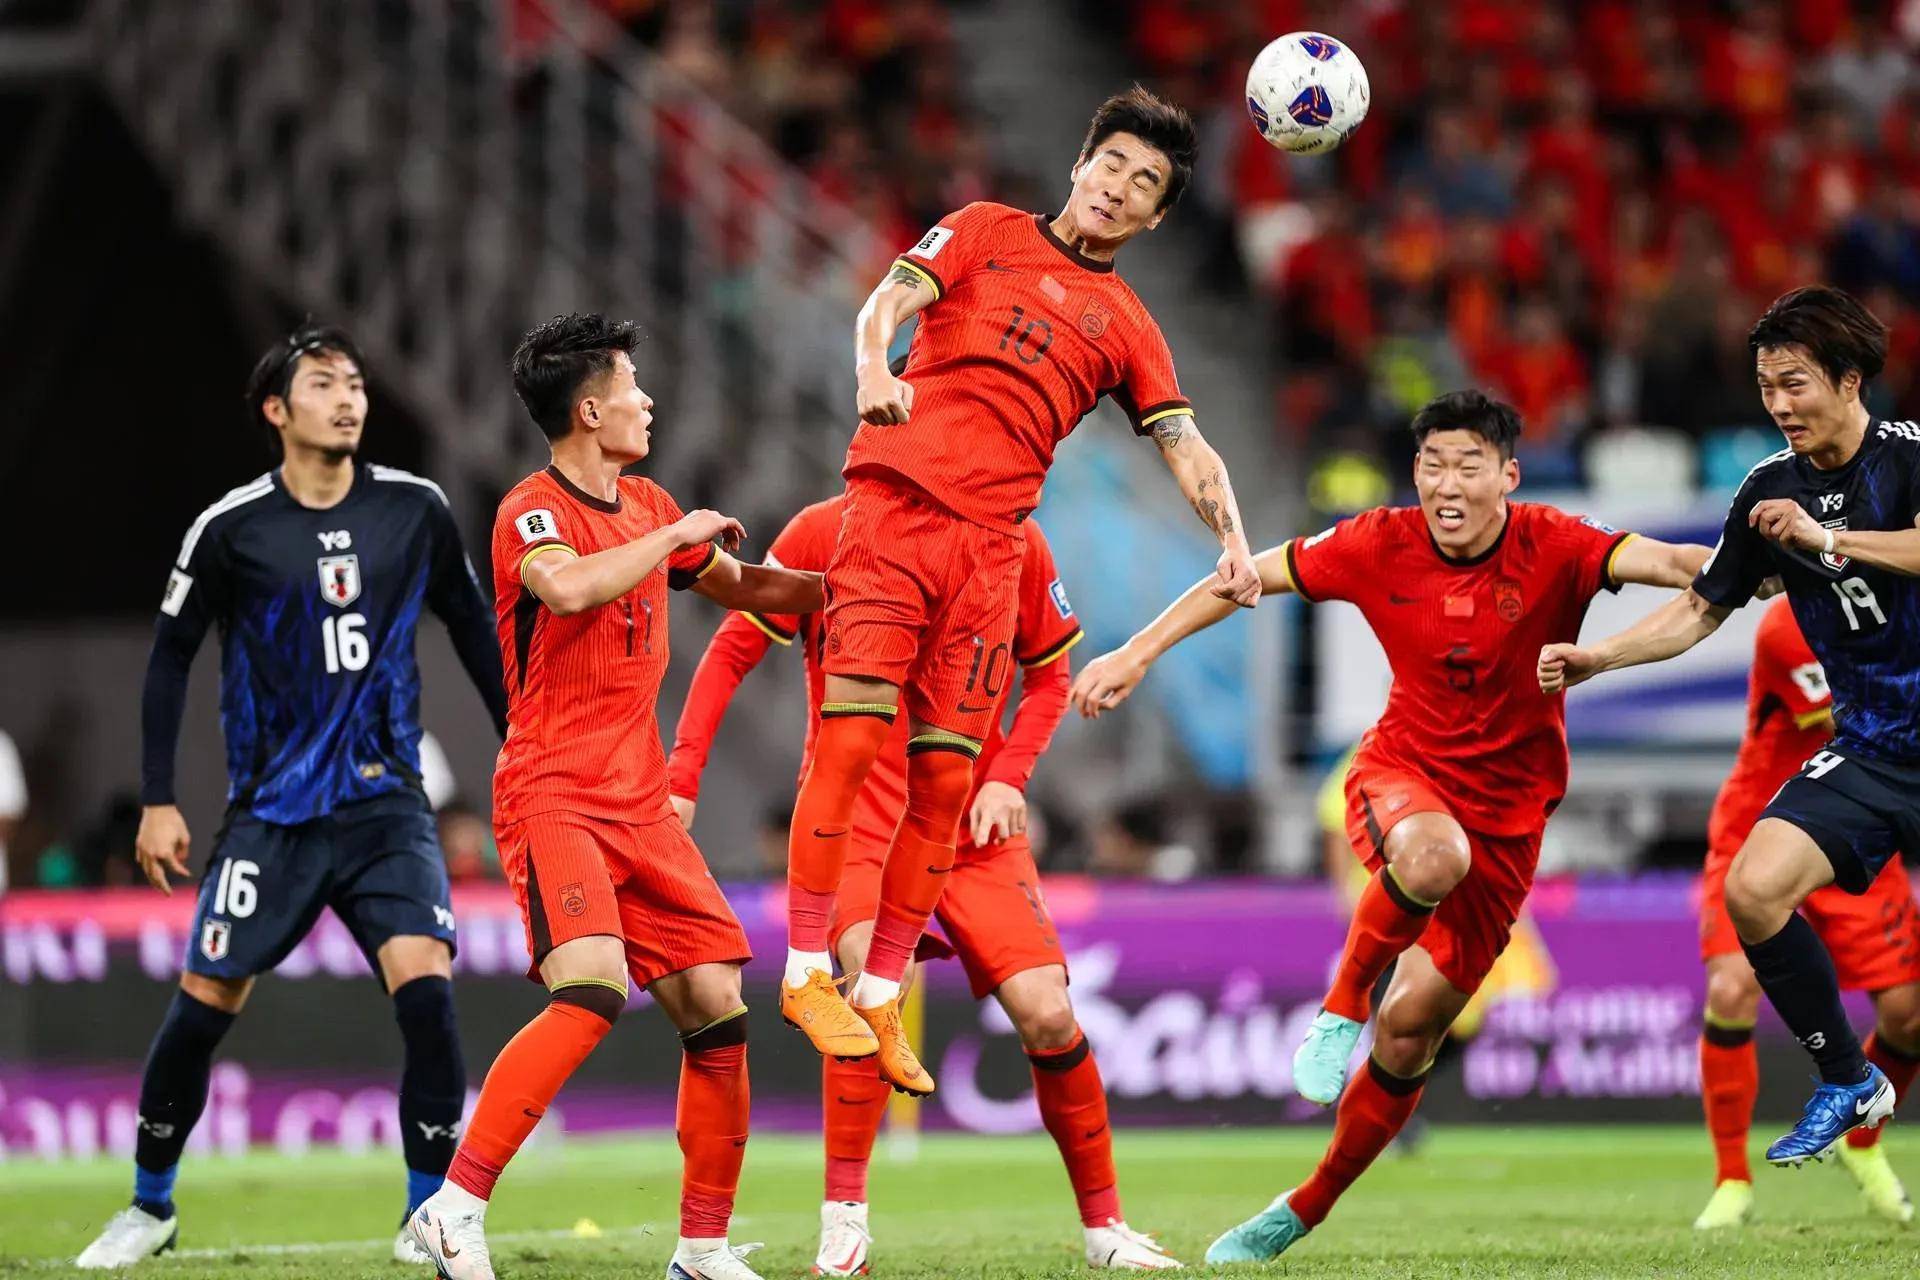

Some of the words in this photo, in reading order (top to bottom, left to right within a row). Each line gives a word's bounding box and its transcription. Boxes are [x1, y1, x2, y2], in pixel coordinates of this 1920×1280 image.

[999, 304, 1054, 366] 10
[1819, 492, 1845, 513] Y-3
[317, 529, 352, 551] Y-3
[1830, 576, 1888, 631] 19
[321, 612, 370, 674] 16
[965, 635, 1009, 697] 10
[1445, 645, 1475, 693] 5
[213, 856, 260, 919] 16
[1794, 1031, 1827, 1050] -3
